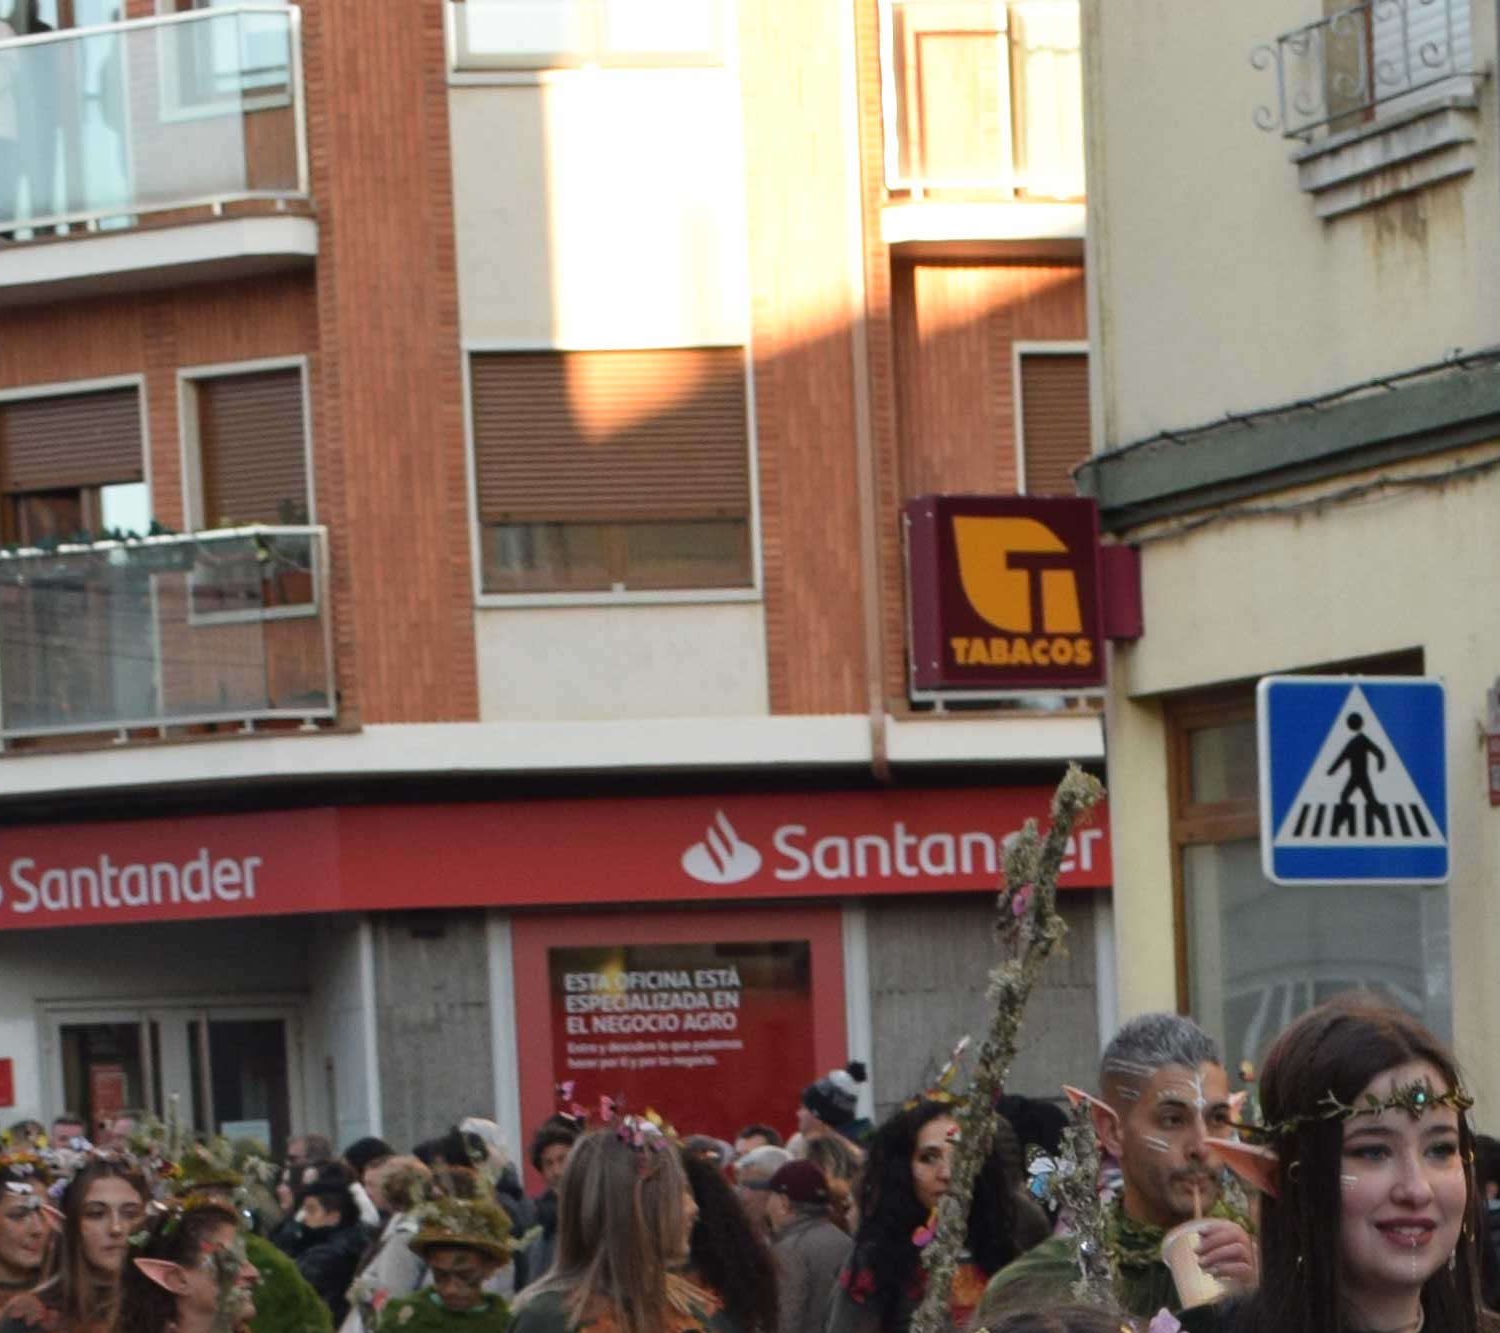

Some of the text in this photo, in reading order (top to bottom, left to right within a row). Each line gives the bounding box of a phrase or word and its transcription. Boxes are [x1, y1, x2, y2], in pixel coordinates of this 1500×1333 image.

[951, 637, 1093, 666] TABACOS
[772, 821, 1103, 881] Santaner
[9, 847, 264, 913] Santander
[566, 967, 740, 992] ESTA OFICINA ESTÁ
[566, 992, 739, 1012] ESPECIALIZADA EN
[567, 1012, 737, 1034] EL NEGOCIO AGRO
